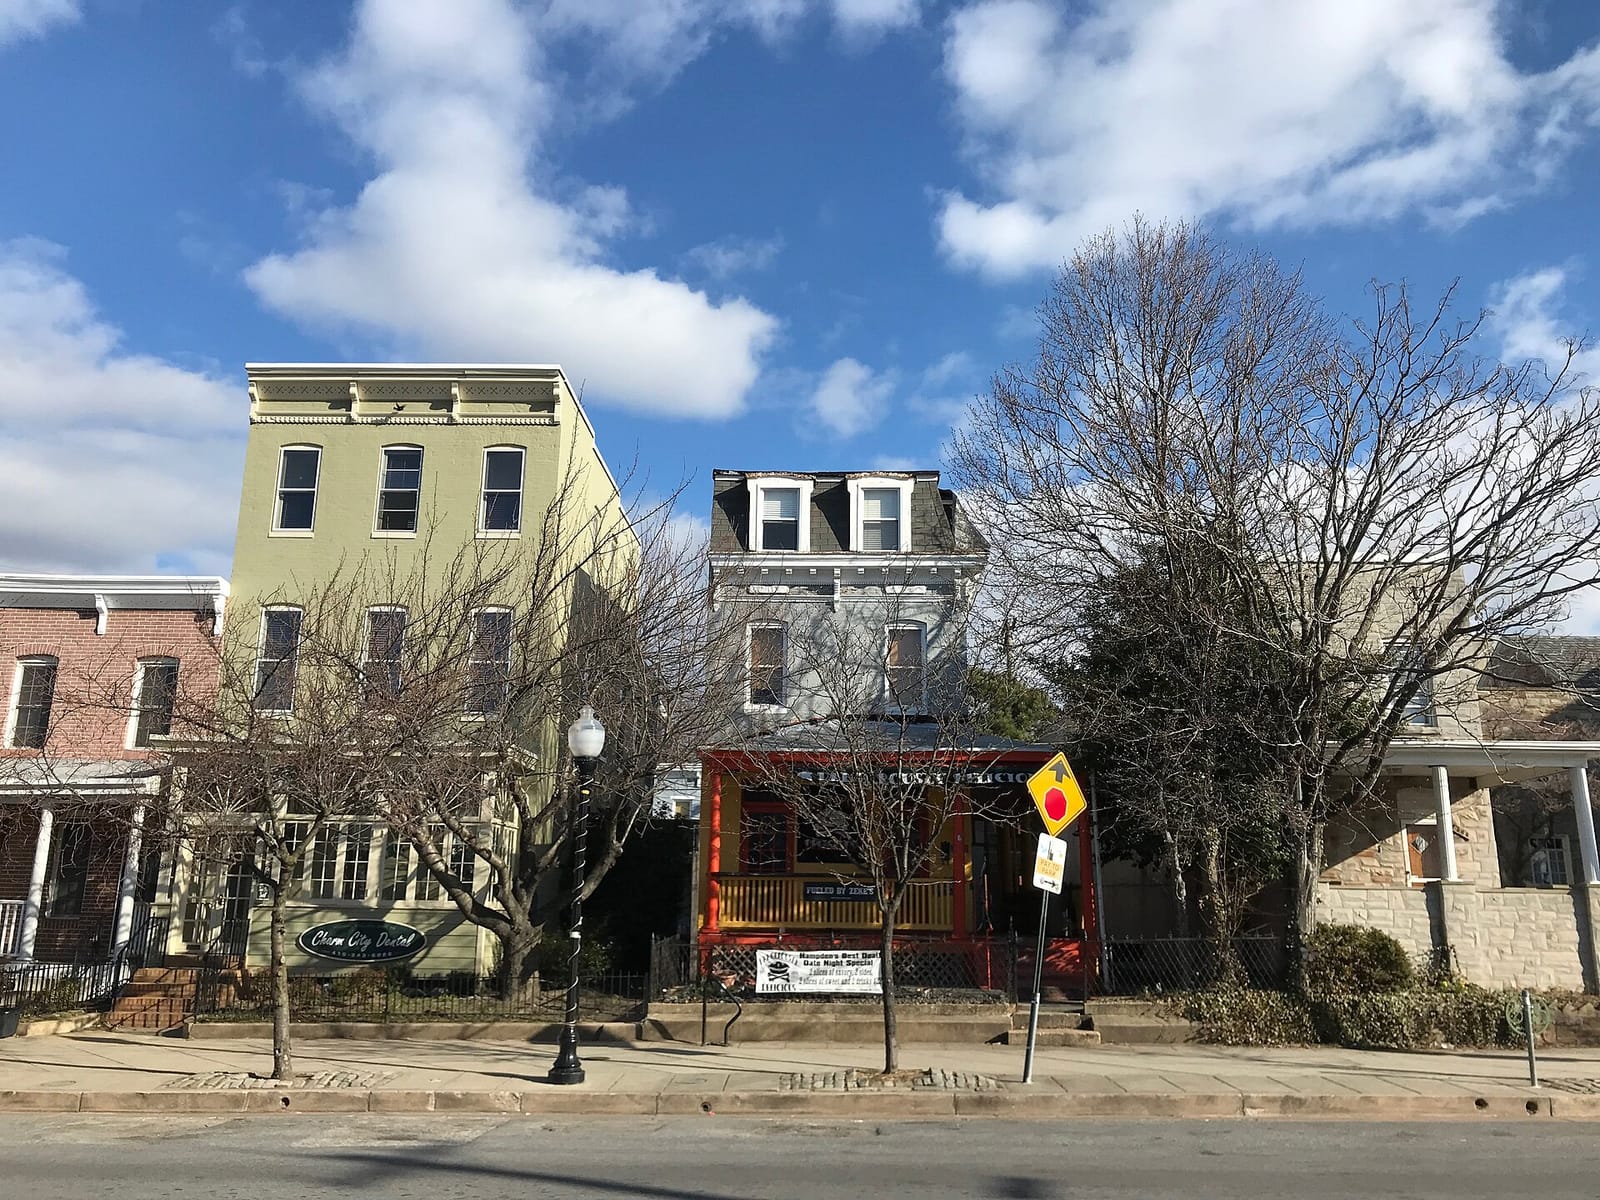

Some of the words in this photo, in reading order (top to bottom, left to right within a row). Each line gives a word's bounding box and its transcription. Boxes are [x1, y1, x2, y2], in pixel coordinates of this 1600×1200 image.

[1041, 867, 1057, 876] PARK
[806, 886, 835, 895] FUELED
[836, 887, 846, 895] BY
[848, 886, 874, 896] ZEKE'S
[311, 930, 345, 947] Charm
[347, 931, 372, 952] City
[376, 932, 416, 948] Dental
[799, 952, 839, 960] Hampden's
[823, 960, 845, 968] Night
[846, 960, 874, 968] Special
